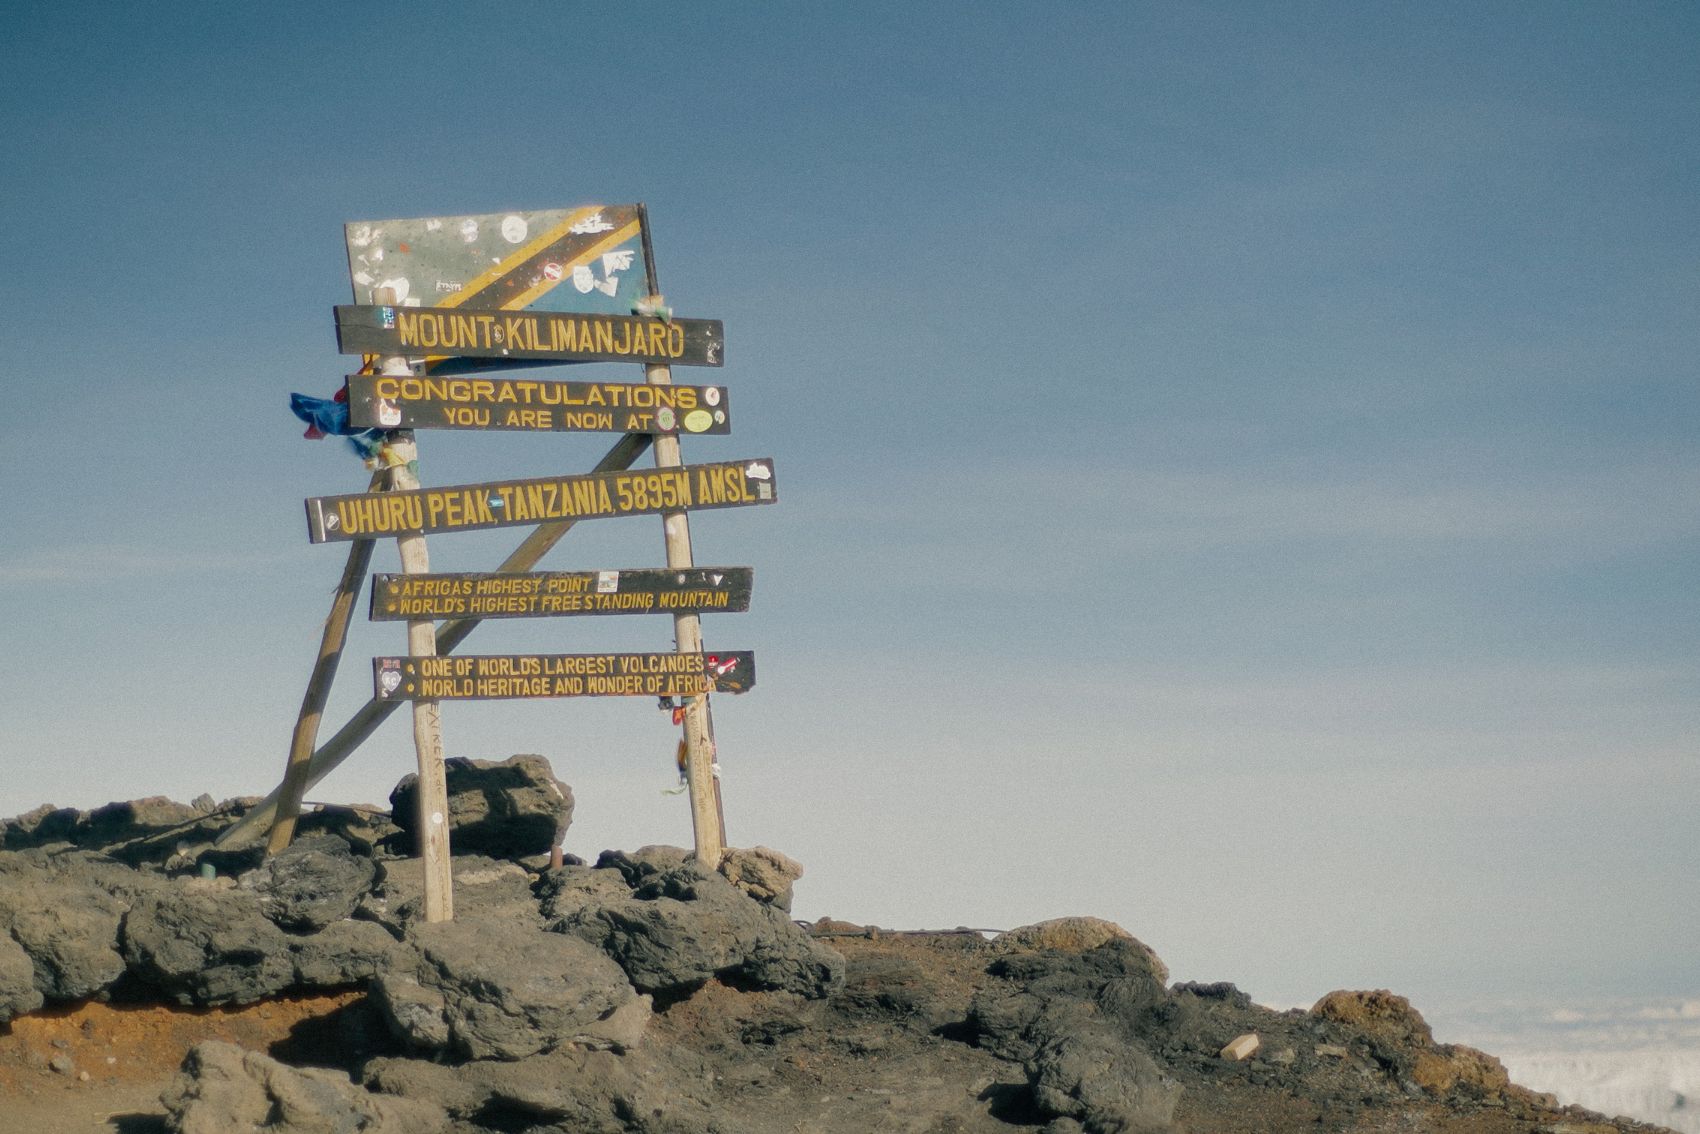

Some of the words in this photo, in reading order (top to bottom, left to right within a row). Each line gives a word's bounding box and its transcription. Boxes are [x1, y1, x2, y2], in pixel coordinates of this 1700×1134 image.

[398, 313, 495, 349] MOUNT
[505, 318, 685, 358] KILIMANJARO
[376, 378, 698, 408] CONGRATULATIONS
[443, 408, 491, 426] YOU
[506, 411, 553, 429] ARE
[566, 414, 613, 430] NOW
[627, 415, 654, 431] AT
[339, 494, 424, 535] UHURU
[616, 471, 692, 511] 5895M
[698, 466, 756, 505] AMSL
[402, 580, 472, 596] AFRICAS
[476, 577, 542, 595] HIGHEST
[548, 577, 592, 593] POINT
[470, 596, 538, 613] HIGHEST
[541, 595, 581, 611] FREE
[584, 593, 654, 610] STANDING
[659, 591, 729, 609] MOUNTAIN
[421, 658, 452, 677] ONE
[456, 658, 474, 676] OF
[545, 655, 616, 675] LARGEST
[620, 655, 704, 673] VOLCANOES
[422, 679, 474, 697] WORLD
[477, 677, 551, 697] HERITAGE
[555, 677, 584, 695] AND
[588, 676, 643, 694] WONDER
[647, 676, 664, 693] OF
